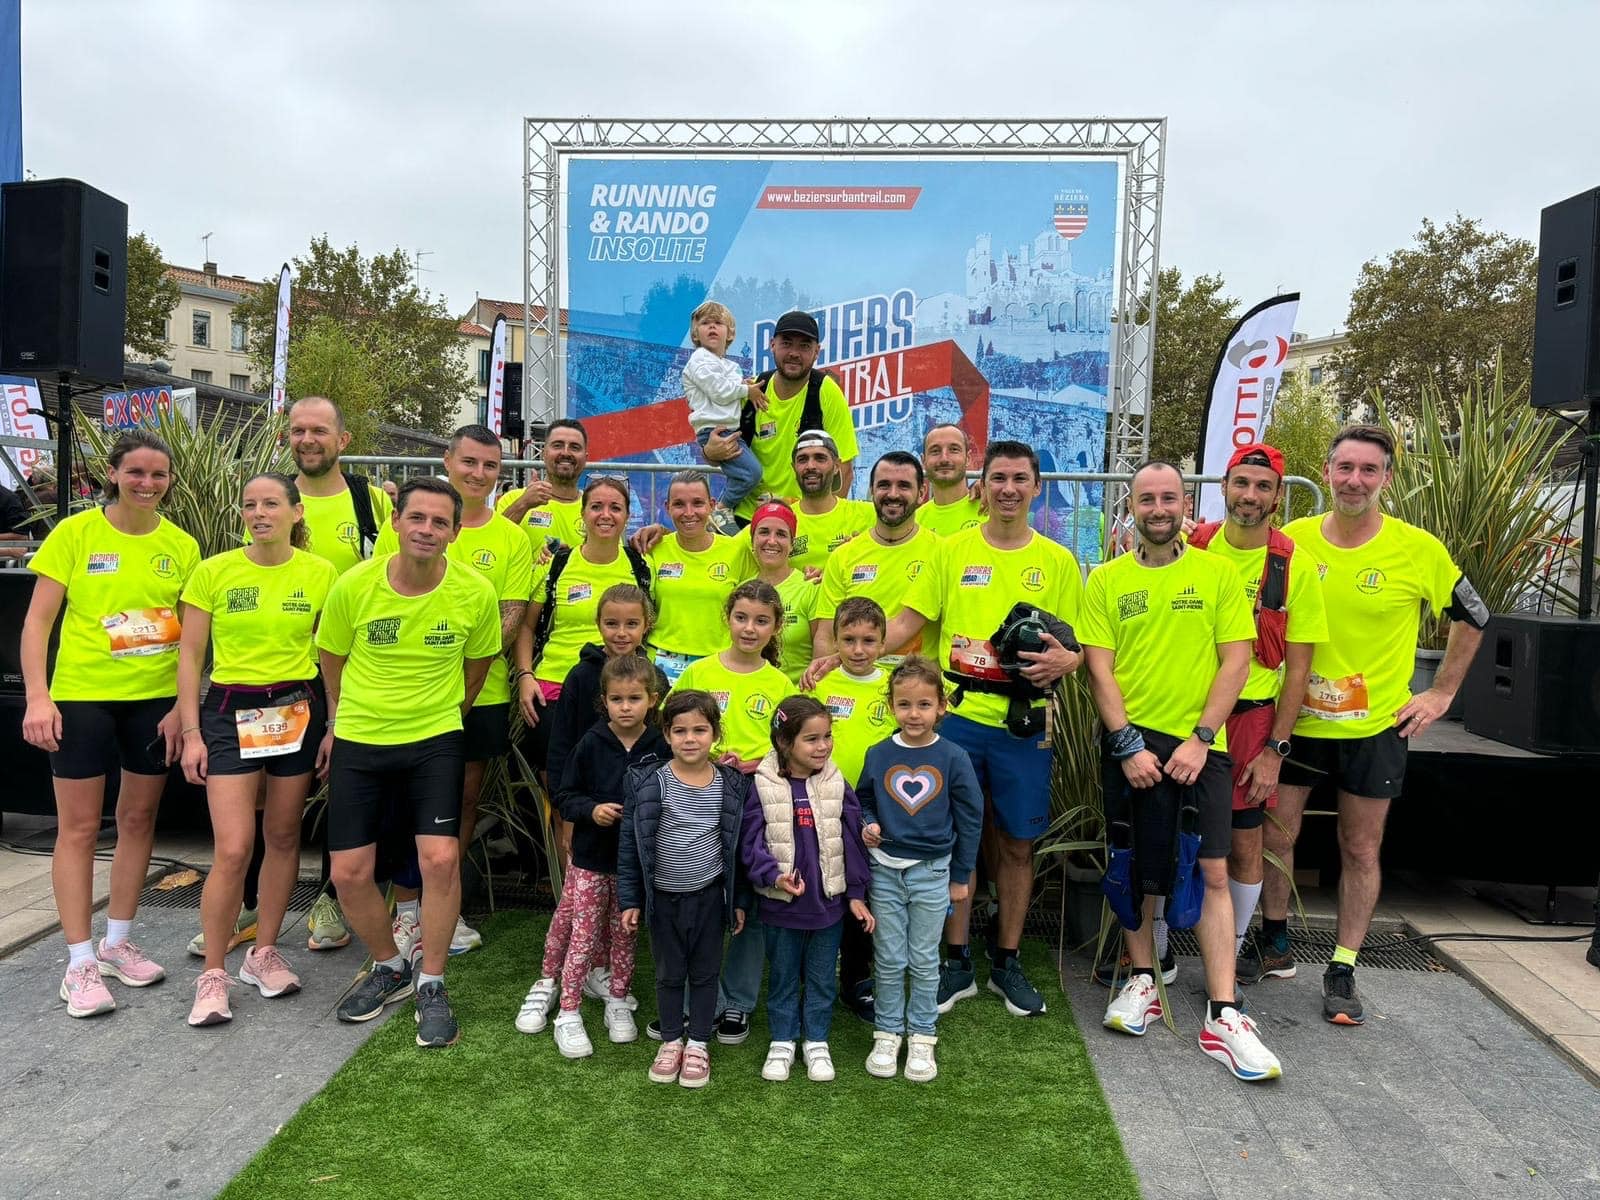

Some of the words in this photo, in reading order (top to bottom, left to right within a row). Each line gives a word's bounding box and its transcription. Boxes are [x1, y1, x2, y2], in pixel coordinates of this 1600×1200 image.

[590, 184, 717, 207] RUNNING
[767, 190, 906, 203] www.beziersurbantrail.com
[589, 211, 610, 233] &
[615, 211, 709, 234] RANDO
[588, 236, 707, 262] INSOLITE
[974, 656, 986, 666] 78
[1320, 691, 1344, 702] 1766
